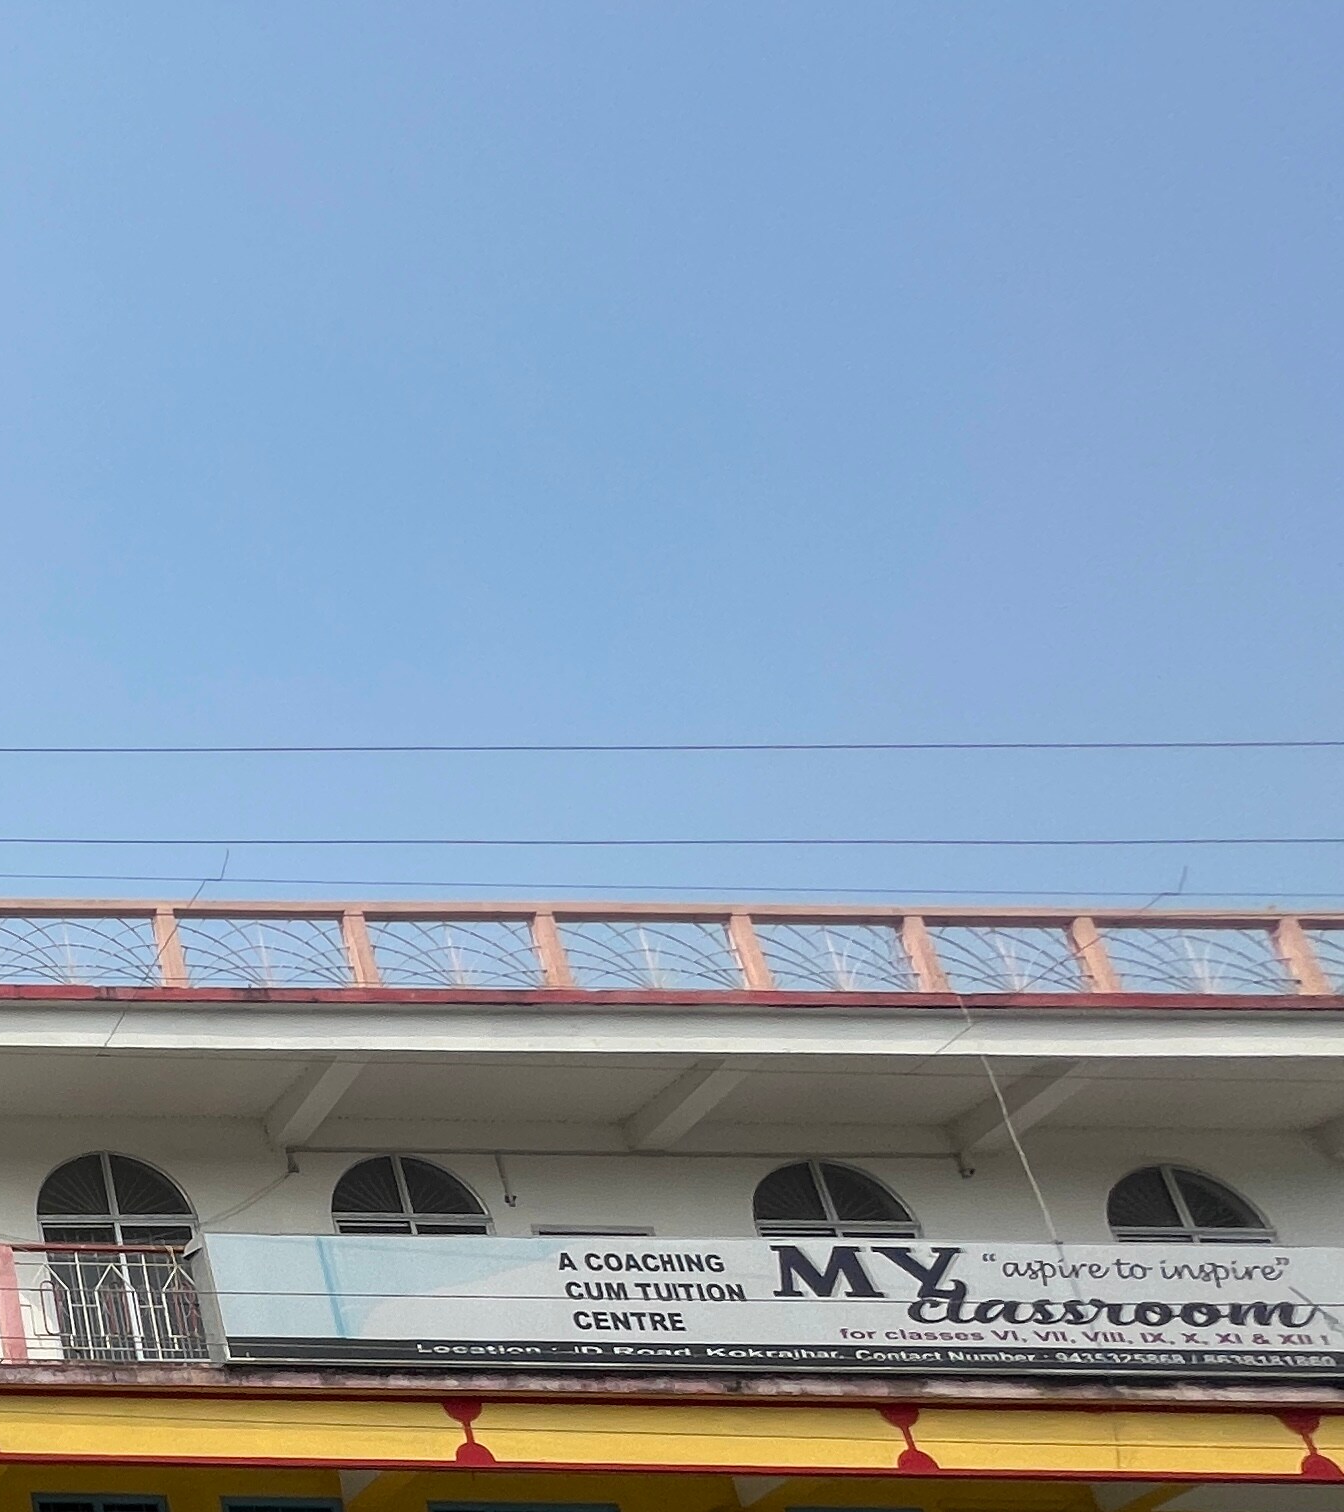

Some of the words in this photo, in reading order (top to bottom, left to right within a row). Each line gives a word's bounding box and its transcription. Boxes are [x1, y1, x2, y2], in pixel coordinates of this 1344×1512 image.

[558, 1252, 578, 1271] A
[584, 1253, 725, 1272] COACHING
[770, 1244, 964, 1299] MY
[1112, 1258, 1153, 1280] to
[565, 1281, 629, 1300] CUM
[635, 1282, 747, 1302] TUITION
[907, 1279, 1319, 1328] classroom
[573, 1310, 686, 1332] CENTRE
[840, 1328, 877, 1341] for
[885, 1329, 985, 1341] classes
[417, 1343, 542, 1355] Location
[855, 1350, 942, 1362] Contact
[948, 1351, 1036, 1363] Number
